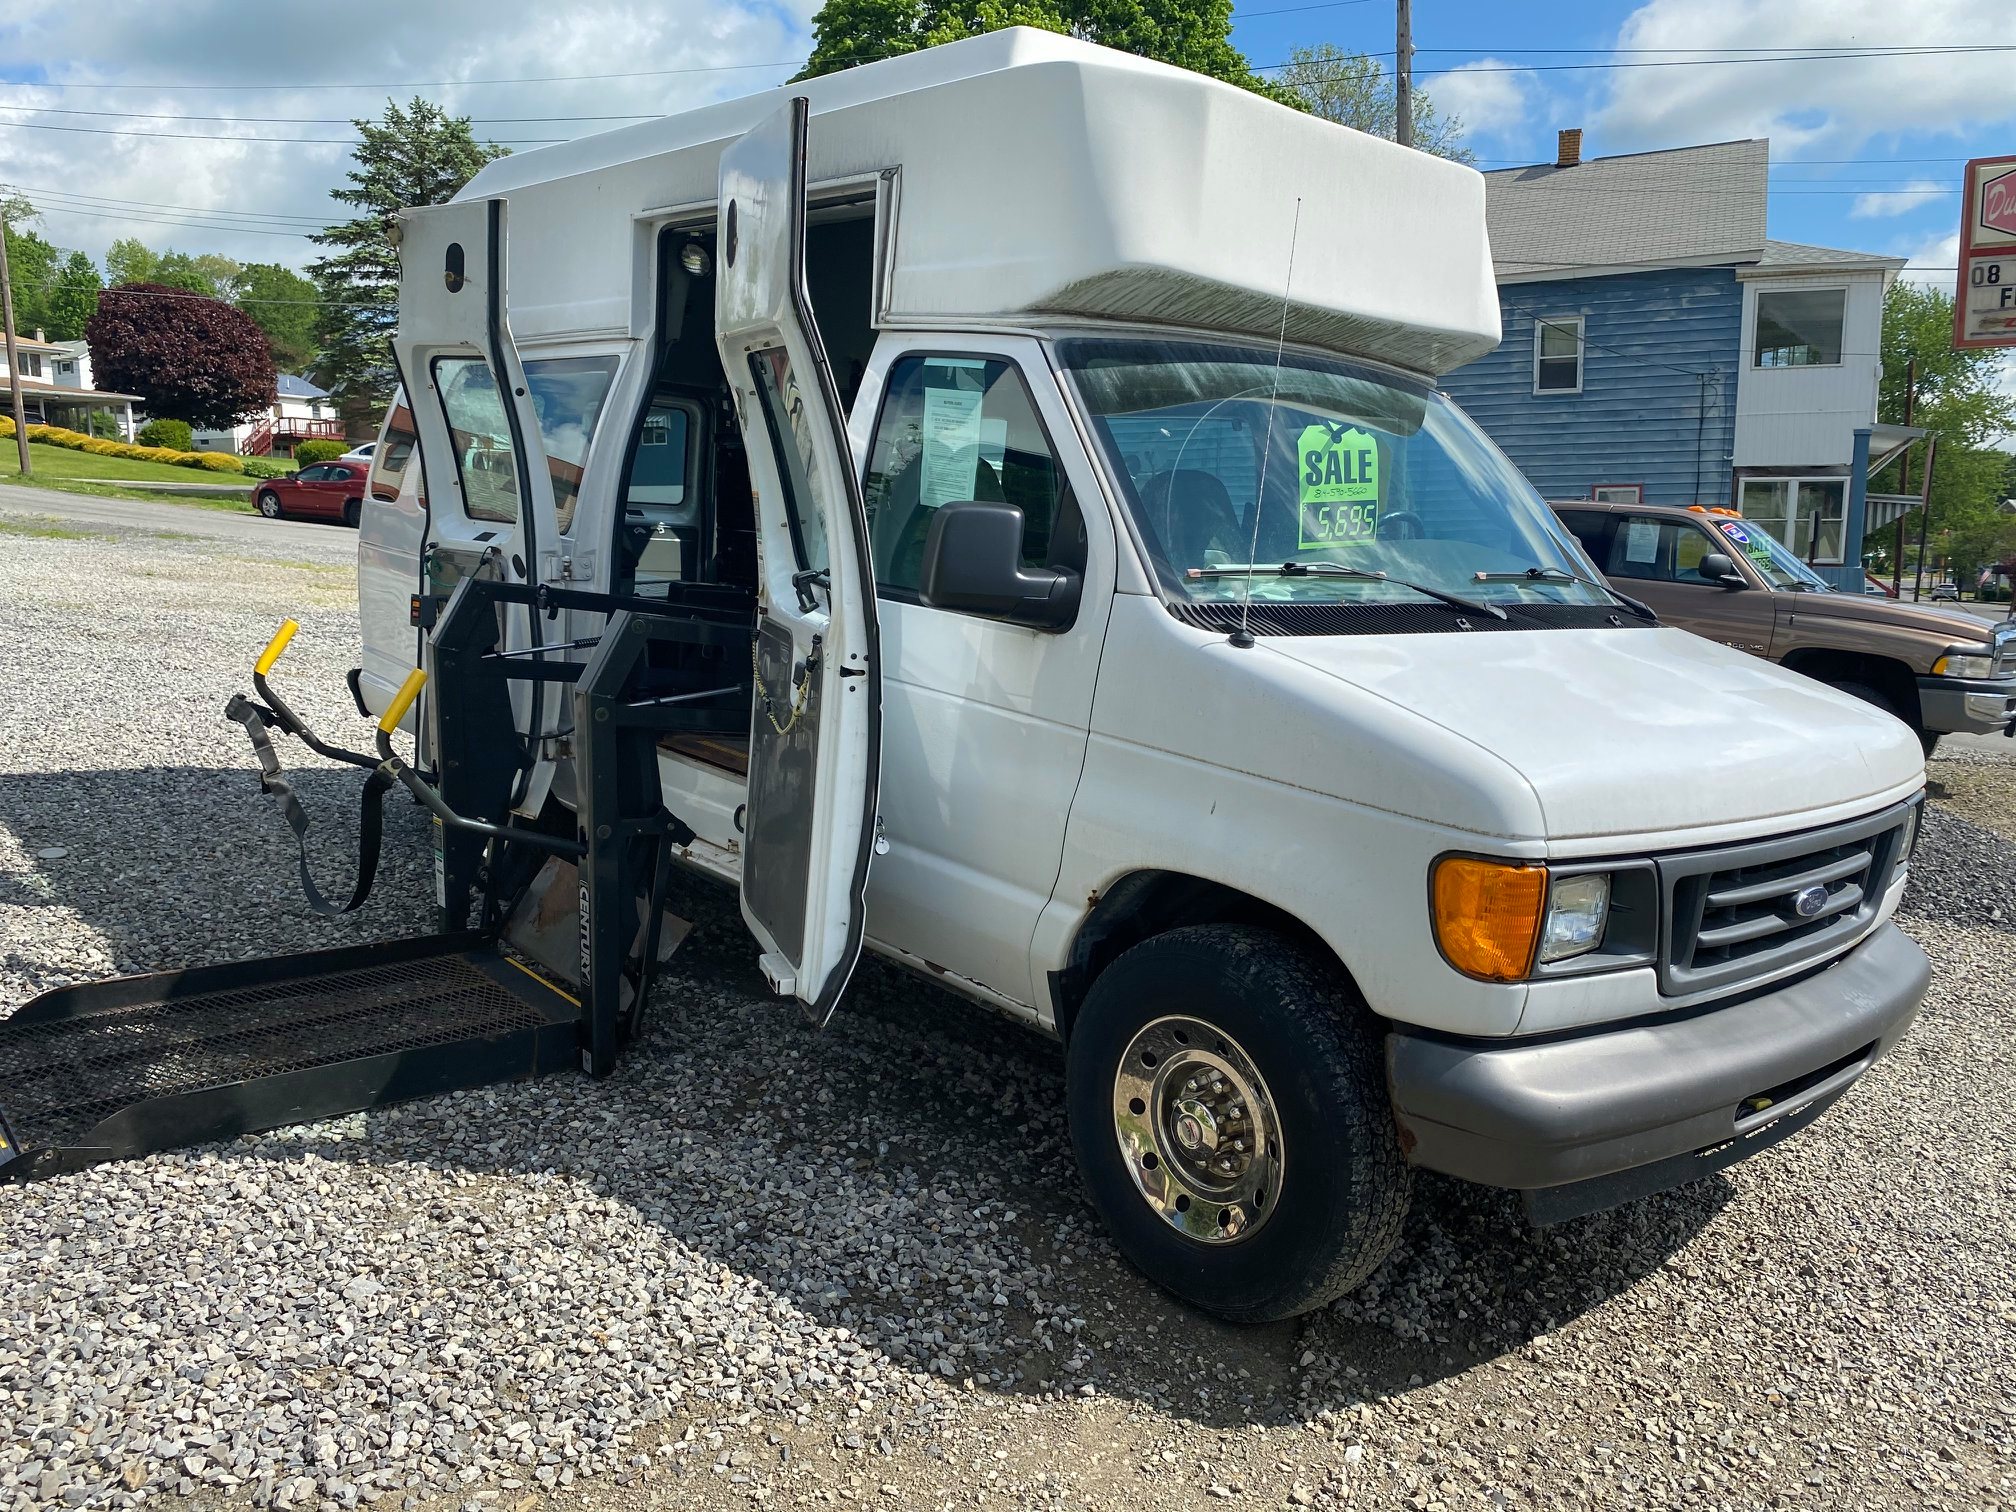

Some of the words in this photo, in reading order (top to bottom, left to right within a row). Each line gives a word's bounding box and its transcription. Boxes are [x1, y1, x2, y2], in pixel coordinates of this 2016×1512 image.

[1971, 264, 2000, 285] 08
[2000, 287, 2016, 308] F
[1305, 449, 1373, 486] SALE
[1317, 504, 1375, 541] 5,695
[579, 886, 592, 981] CENTURY
